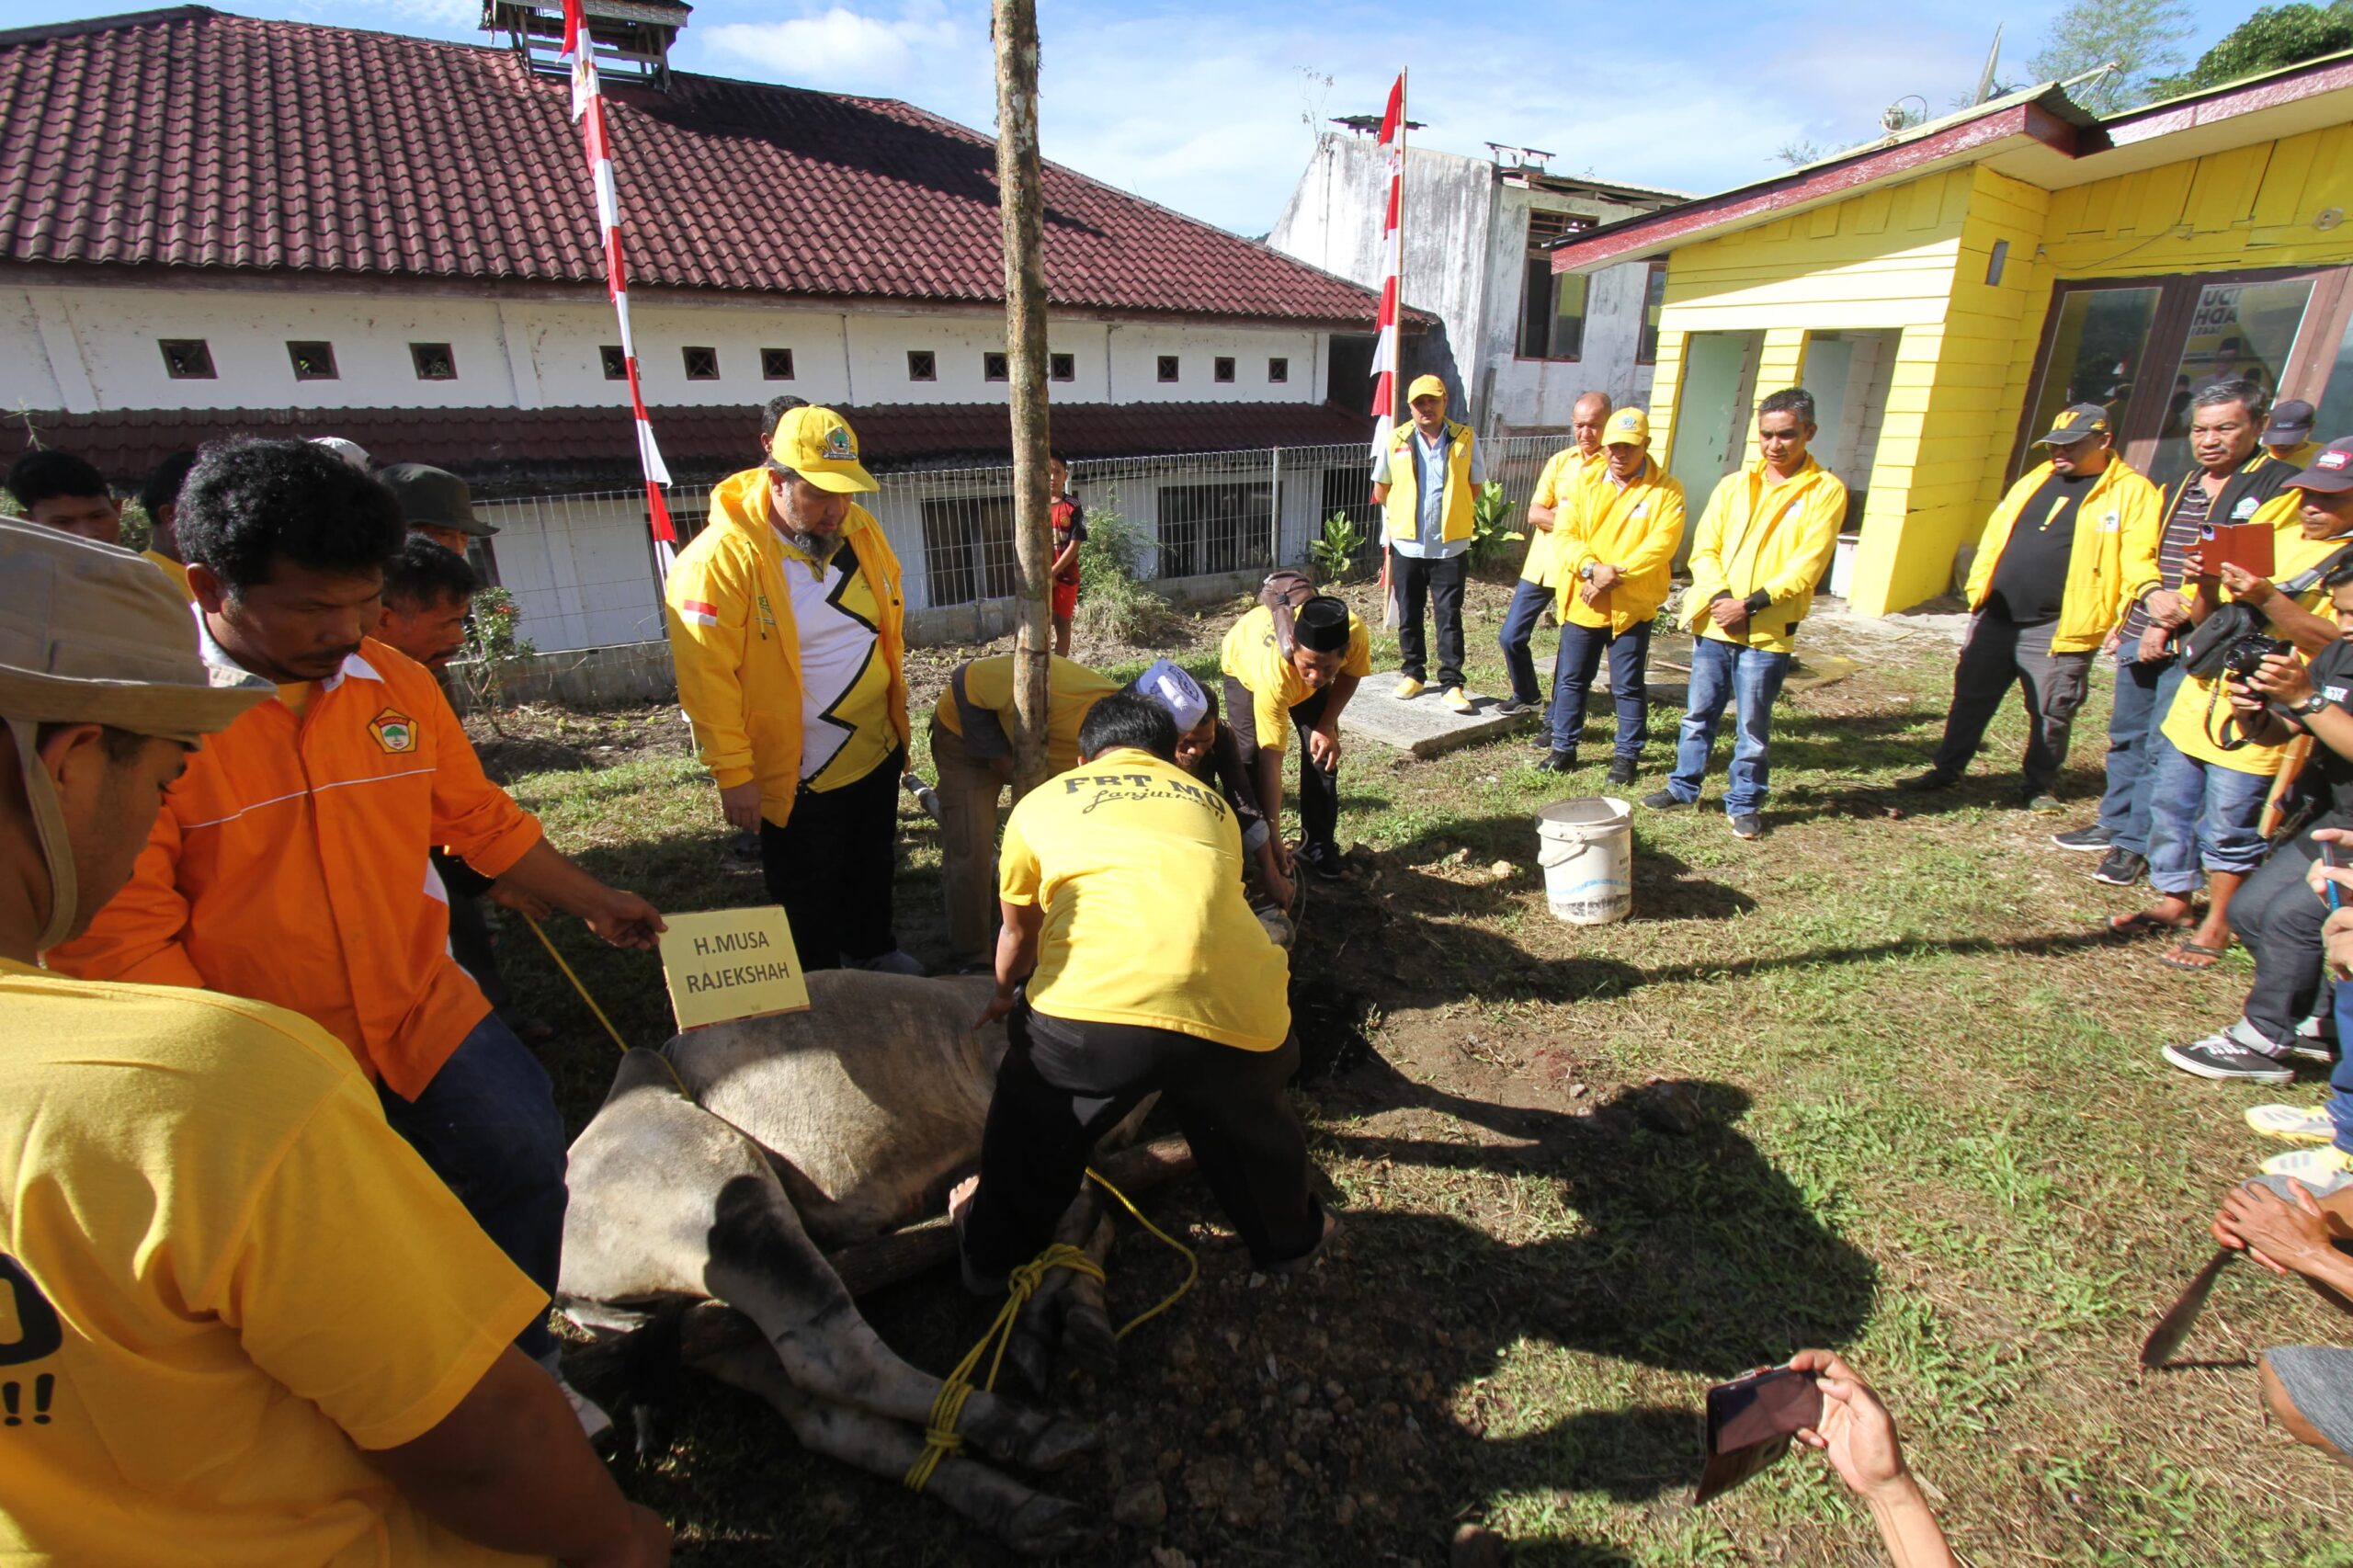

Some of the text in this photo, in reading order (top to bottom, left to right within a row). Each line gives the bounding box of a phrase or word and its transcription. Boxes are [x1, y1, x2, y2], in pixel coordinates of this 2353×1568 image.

[1063, 774, 1153, 795] FRT
[693, 930, 770, 957] H.MUSA
[686, 961, 790, 994] RAJEKSHAH
